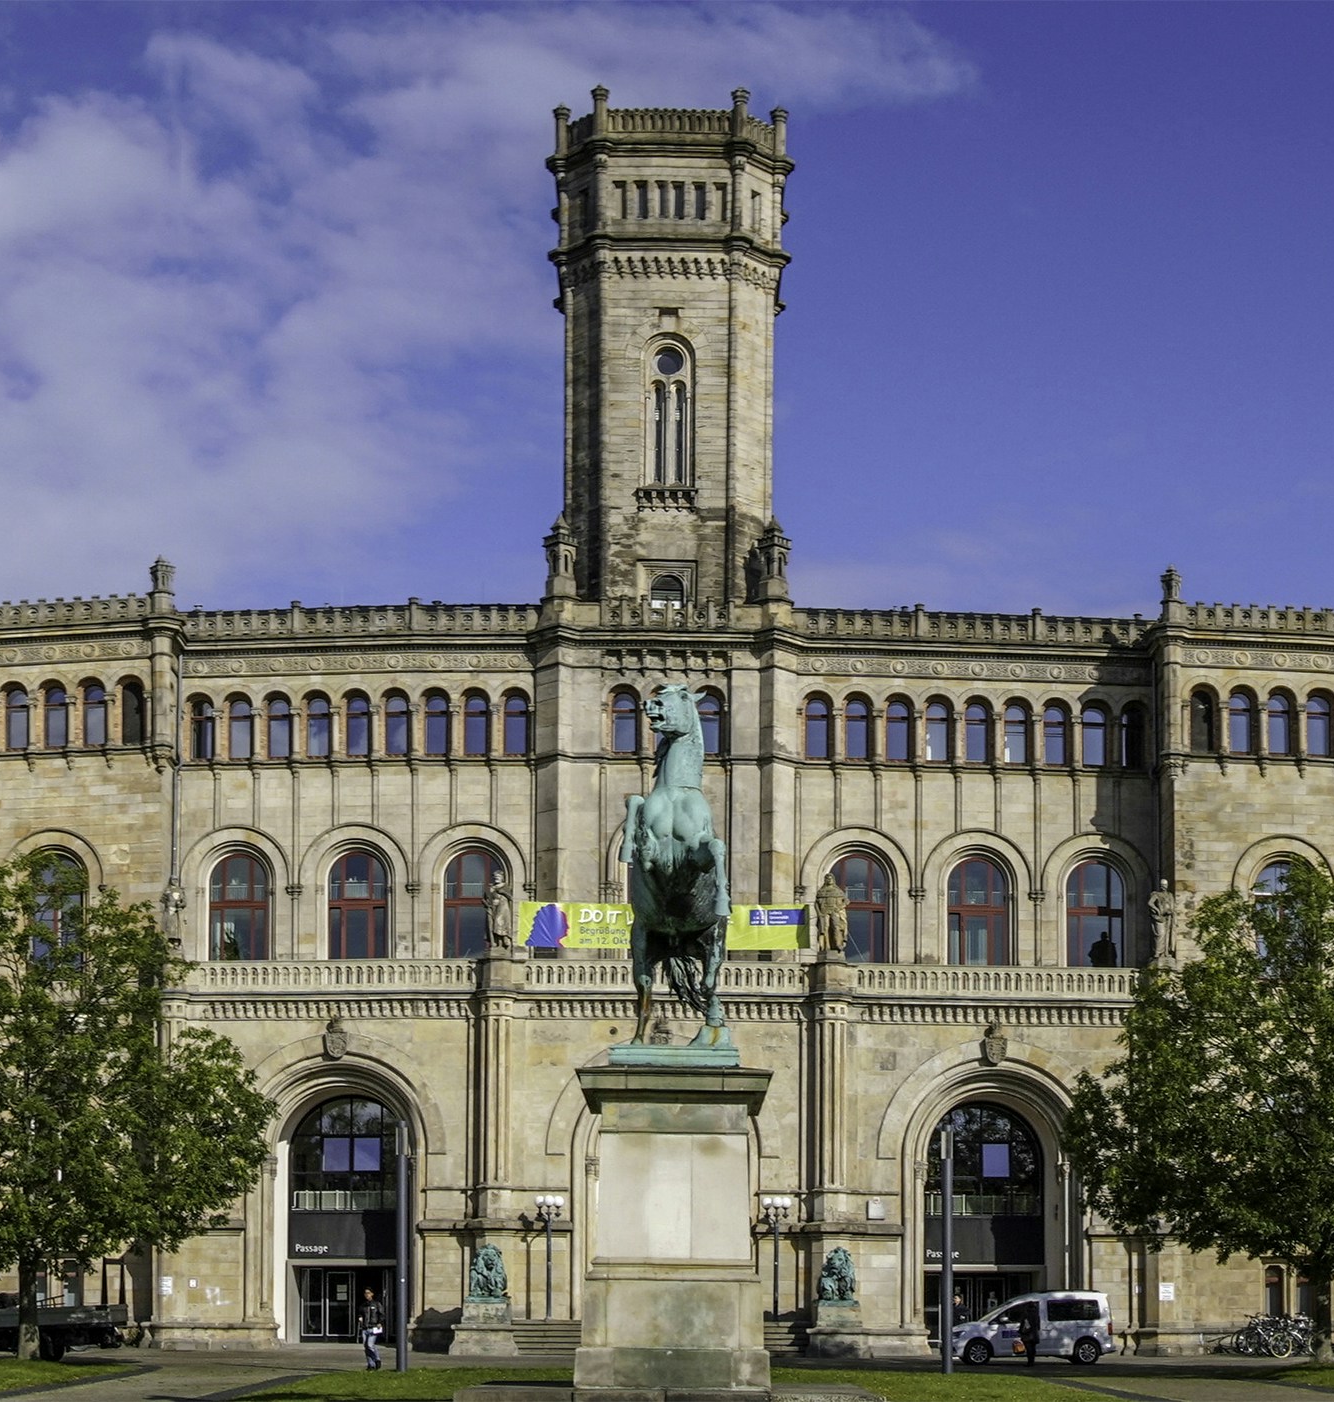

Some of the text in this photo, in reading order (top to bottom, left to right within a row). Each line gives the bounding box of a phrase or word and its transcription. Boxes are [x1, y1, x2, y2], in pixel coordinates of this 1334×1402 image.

[578, 908, 603, 923] DO
[607, 910, 622, 923] IT
[295, 1244, 329, 1254] Passage
